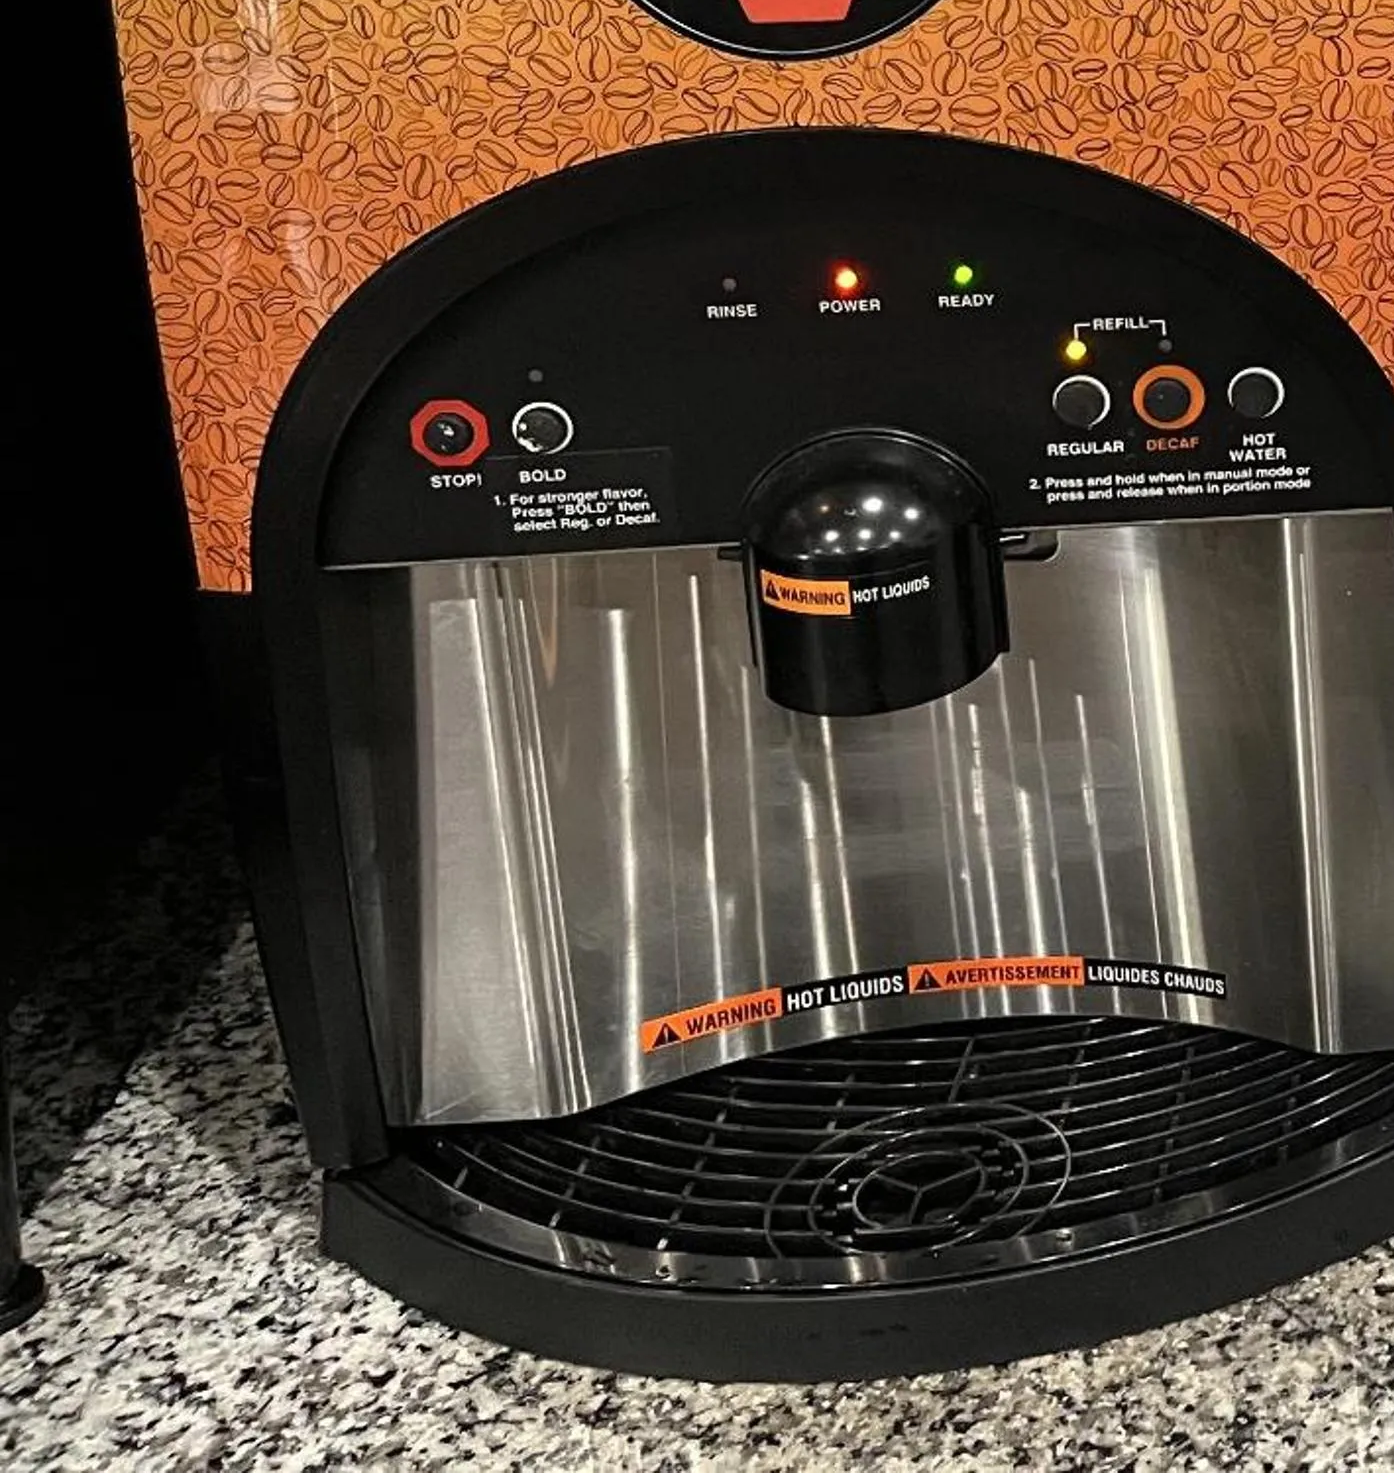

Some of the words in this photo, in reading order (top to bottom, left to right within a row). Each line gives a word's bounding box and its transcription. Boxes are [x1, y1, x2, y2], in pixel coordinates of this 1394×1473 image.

[819, 298, 881, 313] POWER
[938, 294, 995, 308] READY
[707, 304, 757, 319] RINSE
[1093, 316, 1149, 331] REFILL
[1146, 438, 1200, 452] DECAF
[1242, 433, 1275, 447] HOT
[1047, 441, 1125, 457] REGULAR
[1229, 447, 1287, 462] WATER
[430, 473, 482, 489] STOP!
[519, 468, 566, 484] BOLD
[1029, 479, 1041, 490] 2.
[1045, 477, 1083, 489] Press
[1087, 475, 1112, 487] and
[1115, 474, 1145, 486] hold
[1149, 472, 1184, 484] when
[1187, 470, 1201, 482] in
[1204, 468, 1252, 481] manual
[1256, 467, 1293, 479] mode
[1296, 466, 1311, 477] or
[494, 495, 506, 506] 1.
[510, 493, 534, 506] For
[538, 490, 599, 506] stronger
[602, 488, 648, 501] flavor,
[1047, 491, 1084, 504] press
[1088, 488, 1113, 500] and
[1116, 486, 1163, 498] release
[1167, 484, 1203, 496] when
[1207, 482, 1220, 493] in
[1223, 480, 1271, 495] portion
[1274, 478, 1311, 490] mode
[511, 507, 553, 519] Press
[618, 501, 650, 513] then
[514, 519, 557, 533] select
[560, 518, 593, 532] Reg.
[597, 515, 611, 526] or
[779, 586, 845, 606] WARNING
[852, 588, 879, 604] HOT
[882, 575, 930, 600] LIQUIDS
[686, 998, 776, 1035] WARNING
[787, 987, 825, 1012] HOT
[829, 975, 904, 1003] LIQUIDS
[945, 965, 1080, 985] AVERTISSEMENT
[1087, 965, 1159, 985] LIQUIDES
[1163, 971, 1225, 995] CHAUDS
